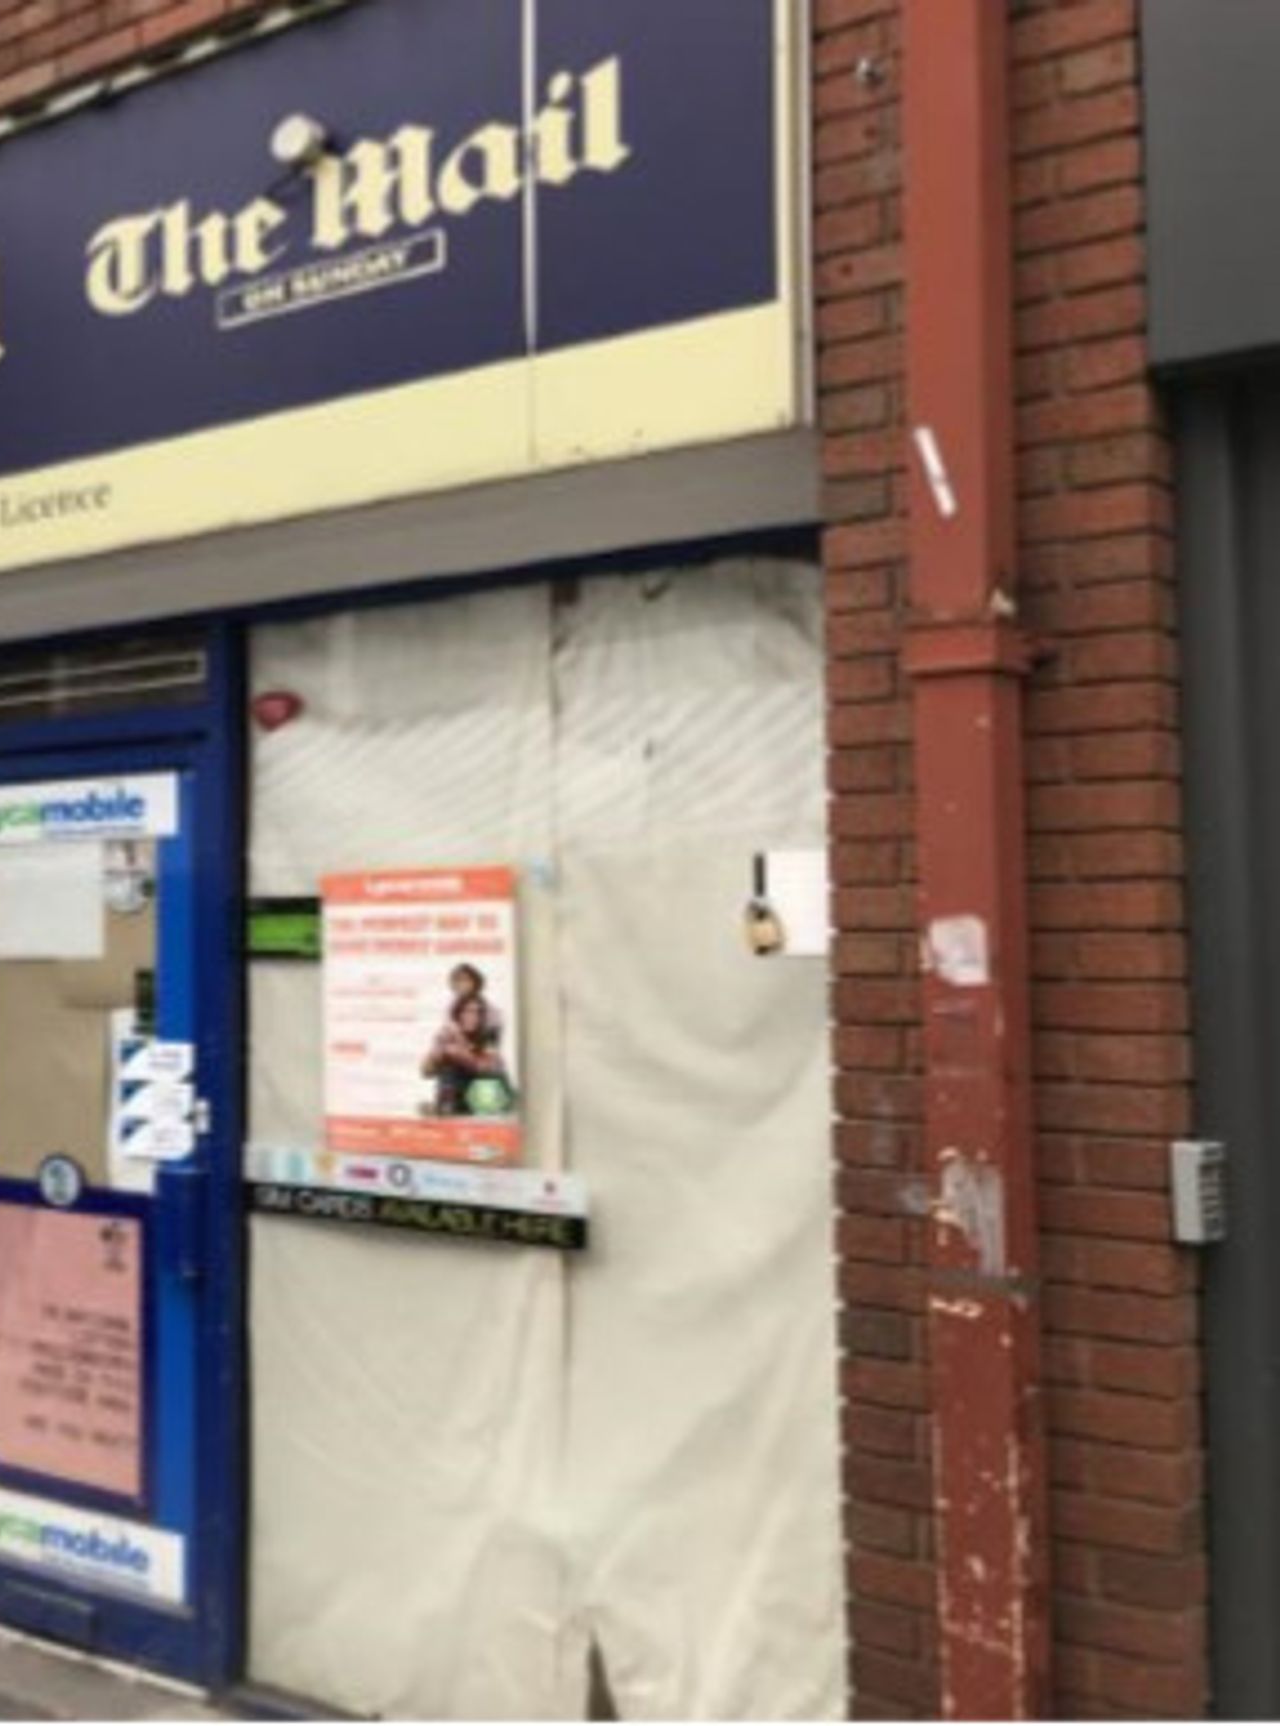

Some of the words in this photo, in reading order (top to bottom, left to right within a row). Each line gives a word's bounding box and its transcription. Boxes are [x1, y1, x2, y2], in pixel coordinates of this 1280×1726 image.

[86, 201, 288, 315] The
[308, 56, 631, 250] Mail
[240, 284, 287, 314] ON
[291, 246, 410, 302] SUNDAY
